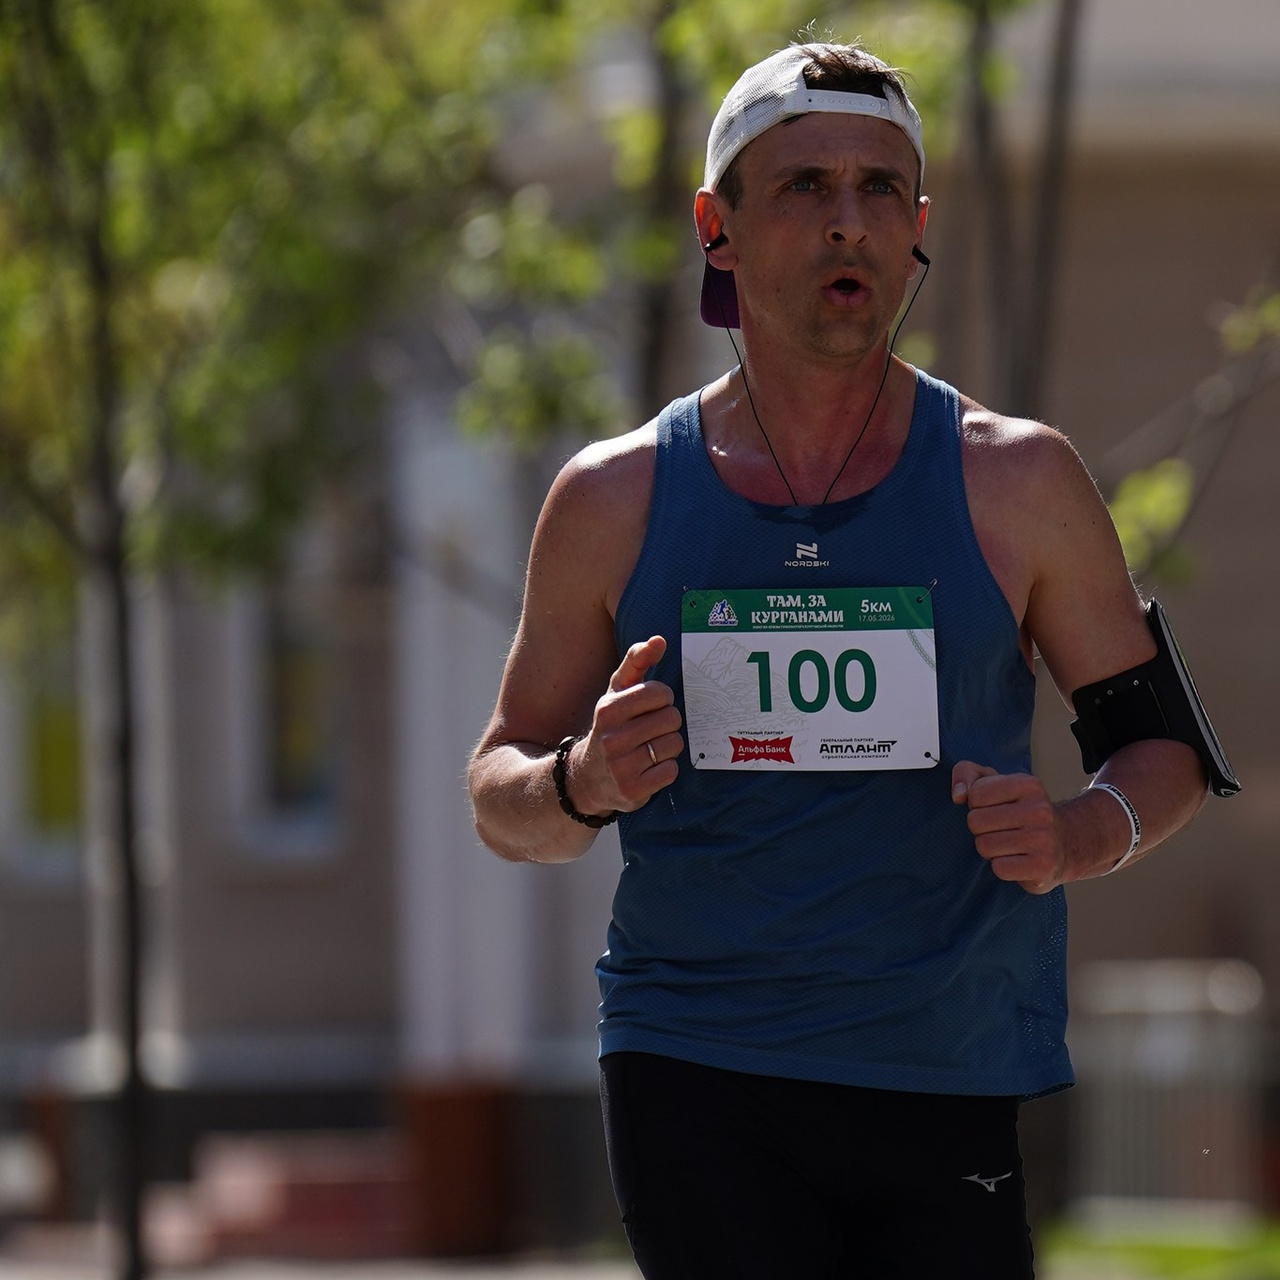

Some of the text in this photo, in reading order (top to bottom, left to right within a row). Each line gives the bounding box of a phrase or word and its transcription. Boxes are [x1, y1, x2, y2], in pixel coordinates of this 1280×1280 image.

[766, 595, 827, 609] ТАМ, ЗА
[751, 610, 844, 624] КУРГАНАМИ
[858, 614, 896, 622] 17.05.2026
[746, 648, 877, 713] 100
[738, 745, 786, 755] Альфа Банк
